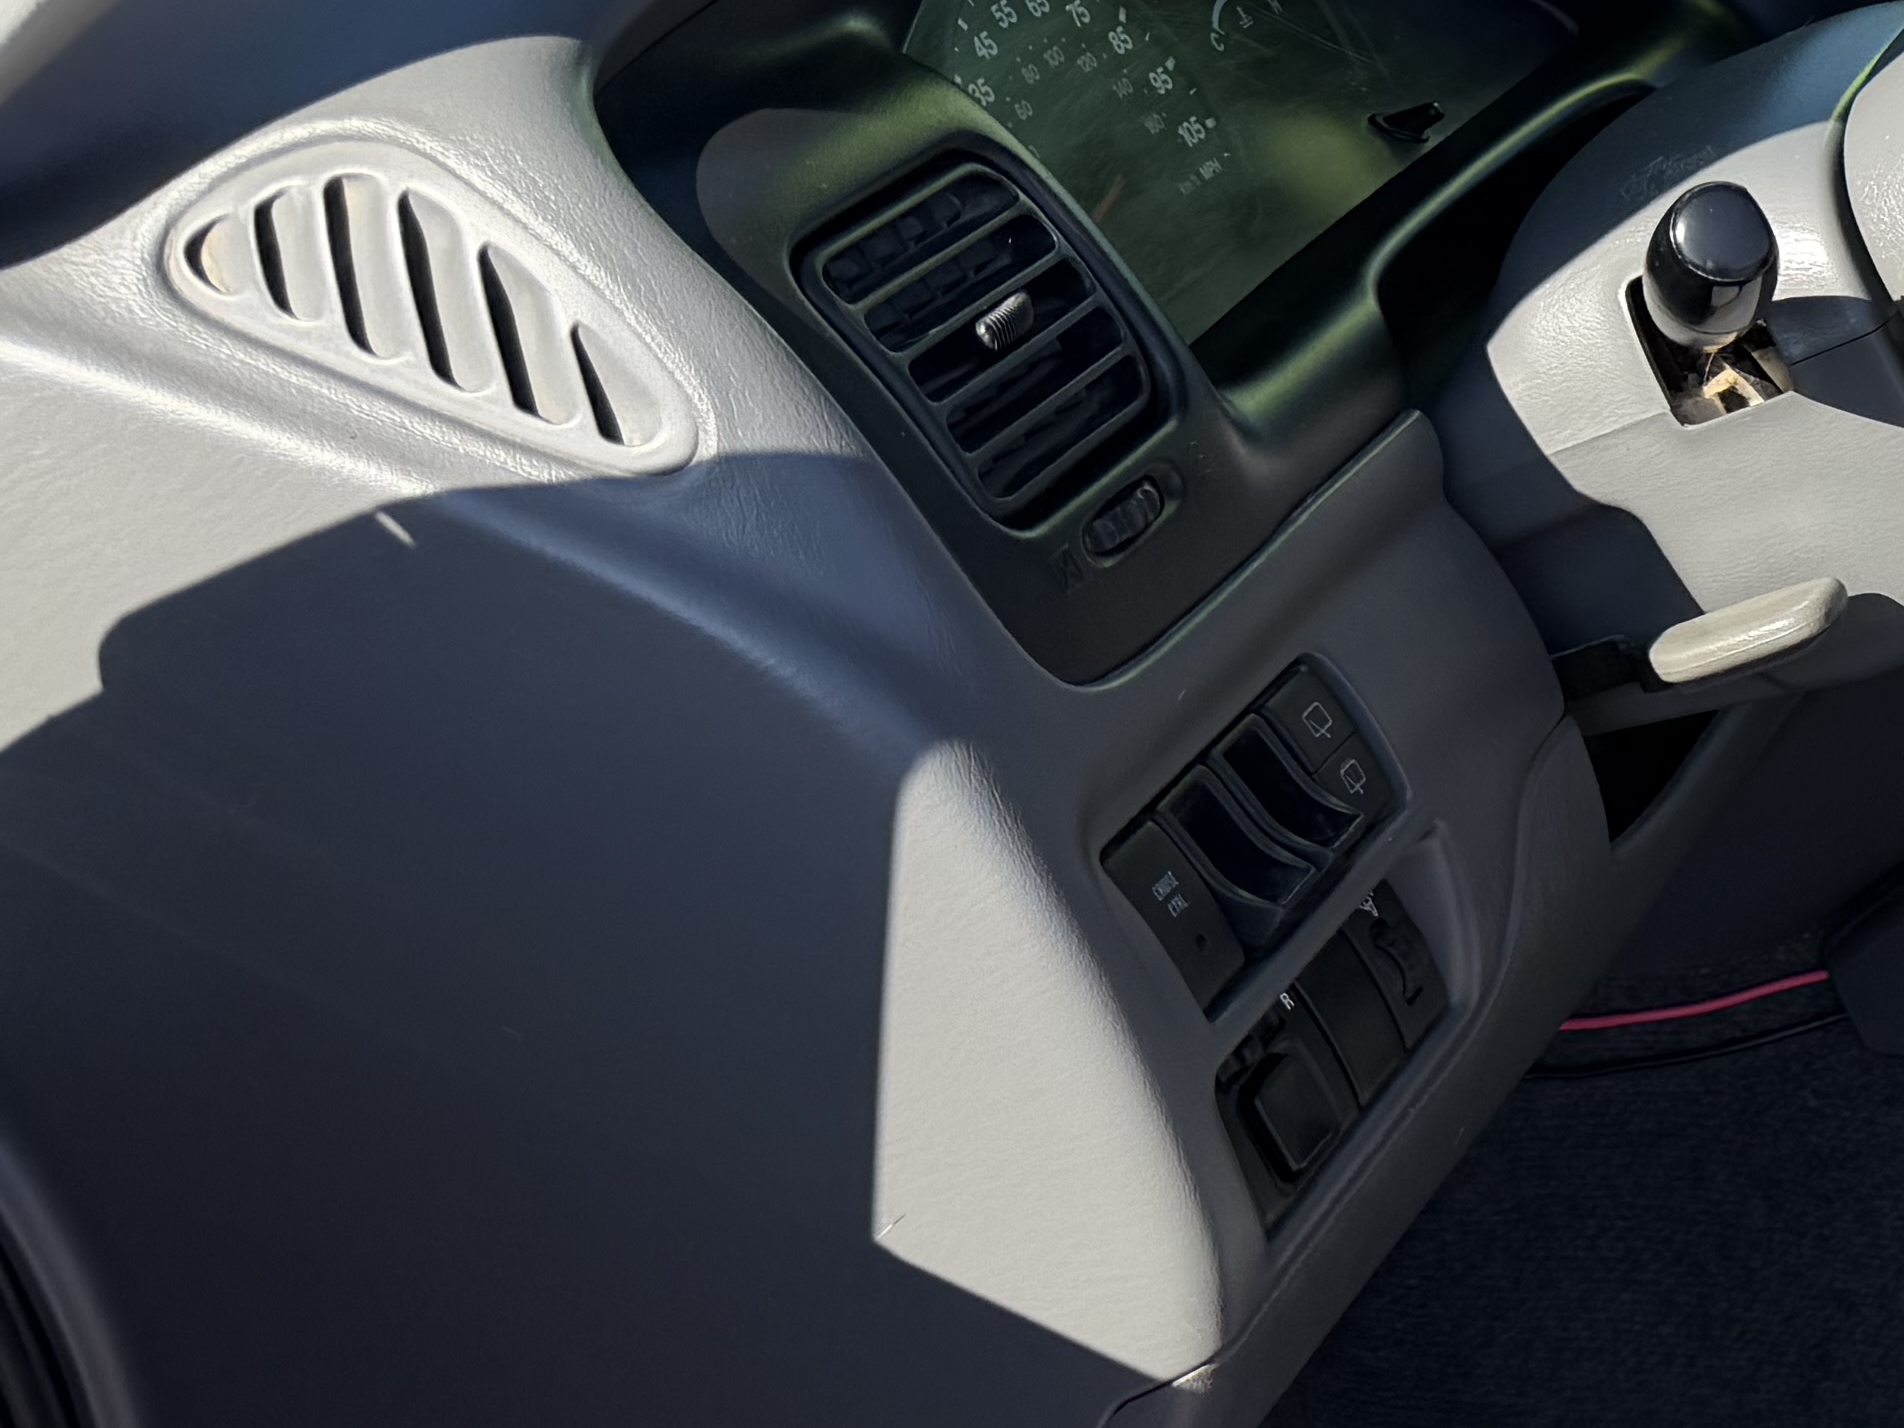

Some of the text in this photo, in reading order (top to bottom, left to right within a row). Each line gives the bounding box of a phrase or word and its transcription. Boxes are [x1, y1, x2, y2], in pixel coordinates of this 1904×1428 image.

[990, 0, 1018, 29] 55
[973, 30, 998, 60] 45
[1107, 25, 1133, 56] 85
[967, 77, 995, 107] 35
[1148, 65, 1174, 96] 95
[1177, 115, 1207, 148] 105
